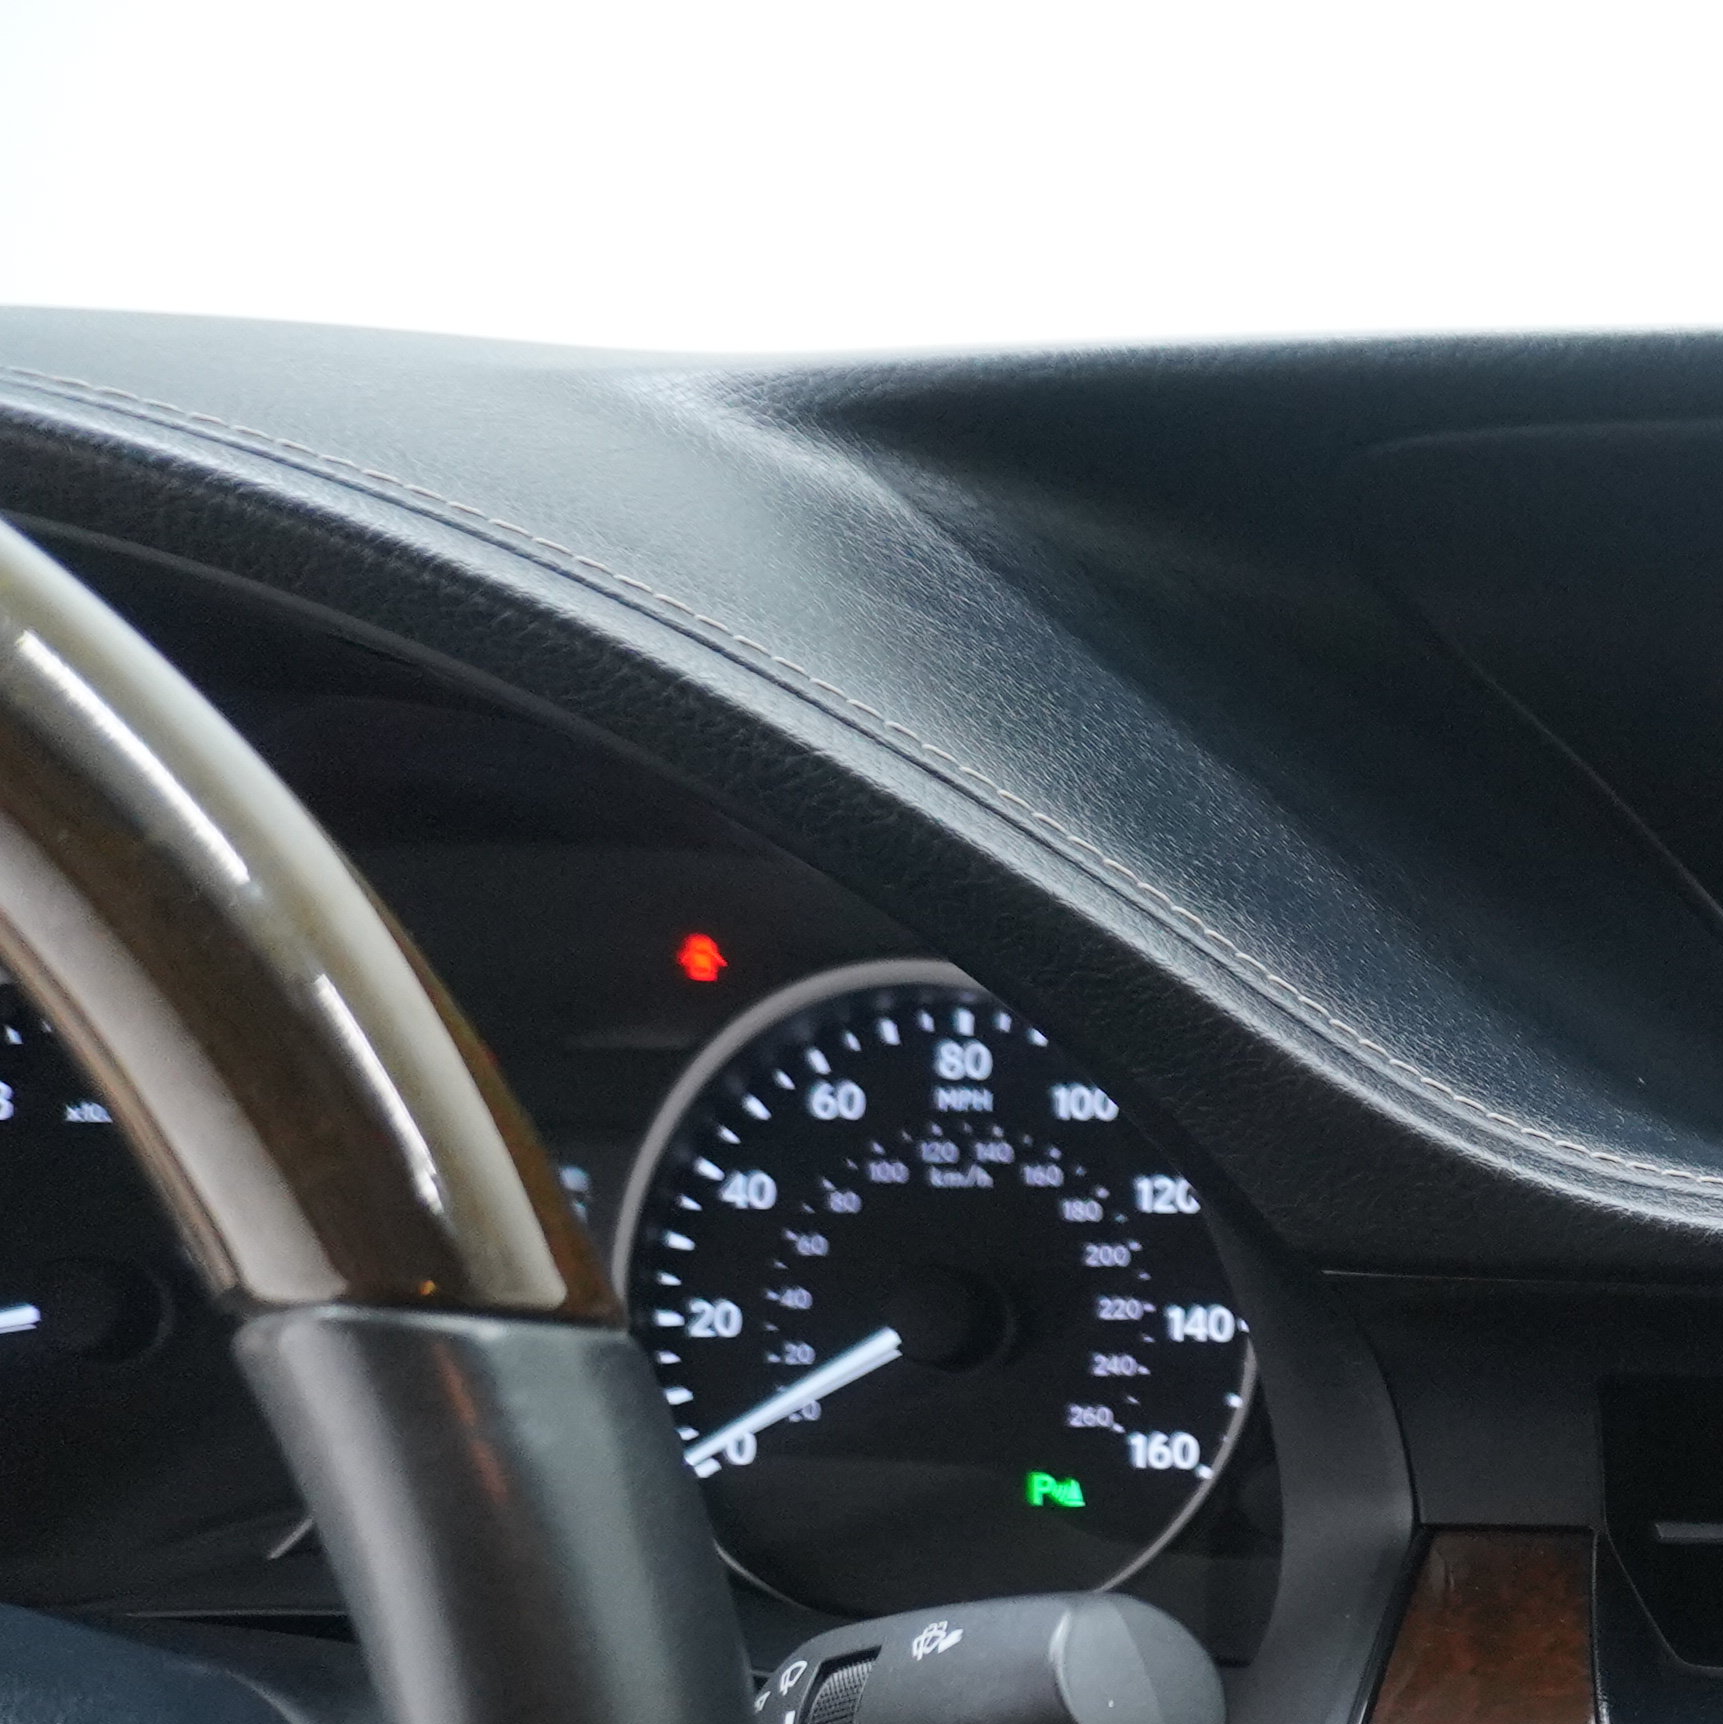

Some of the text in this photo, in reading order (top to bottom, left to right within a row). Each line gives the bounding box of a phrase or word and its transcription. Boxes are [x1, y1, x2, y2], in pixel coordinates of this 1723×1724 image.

[936, 1040, 993, 1081] 80
[810, 1079, 866, 1120] 60
[934, 1086, 994, 1112] MPH
[1050, 1083, 1119, 1122] 100
[920, 1141, 960, 1164] 120
[974, 1141, 1015, 1164] 140
[869, 1161, 909, 1183] 100
[1022, 1163, 1064, 1187] 160
[721, 1169, 777, 1210] 40
[1134, 1174, 1201, 1215] 120
[1061, 1199, 1103, 1223] 180
[1084, 1244, 1131, 1267] 200
[687, 1299, 742, 1338] 20
[1097, 1297, 1144, 1321] 220
[1165, 1304, 1235, 1342] 140
[783, 1342, 816, 1366] 20
[1091, 1354, 1138, 1377] 240
[1066, 1404, 1113, 1428] 260
[726, 1432, 757, 1466] 0
[1127, 1431, 1200, 1469] 160
